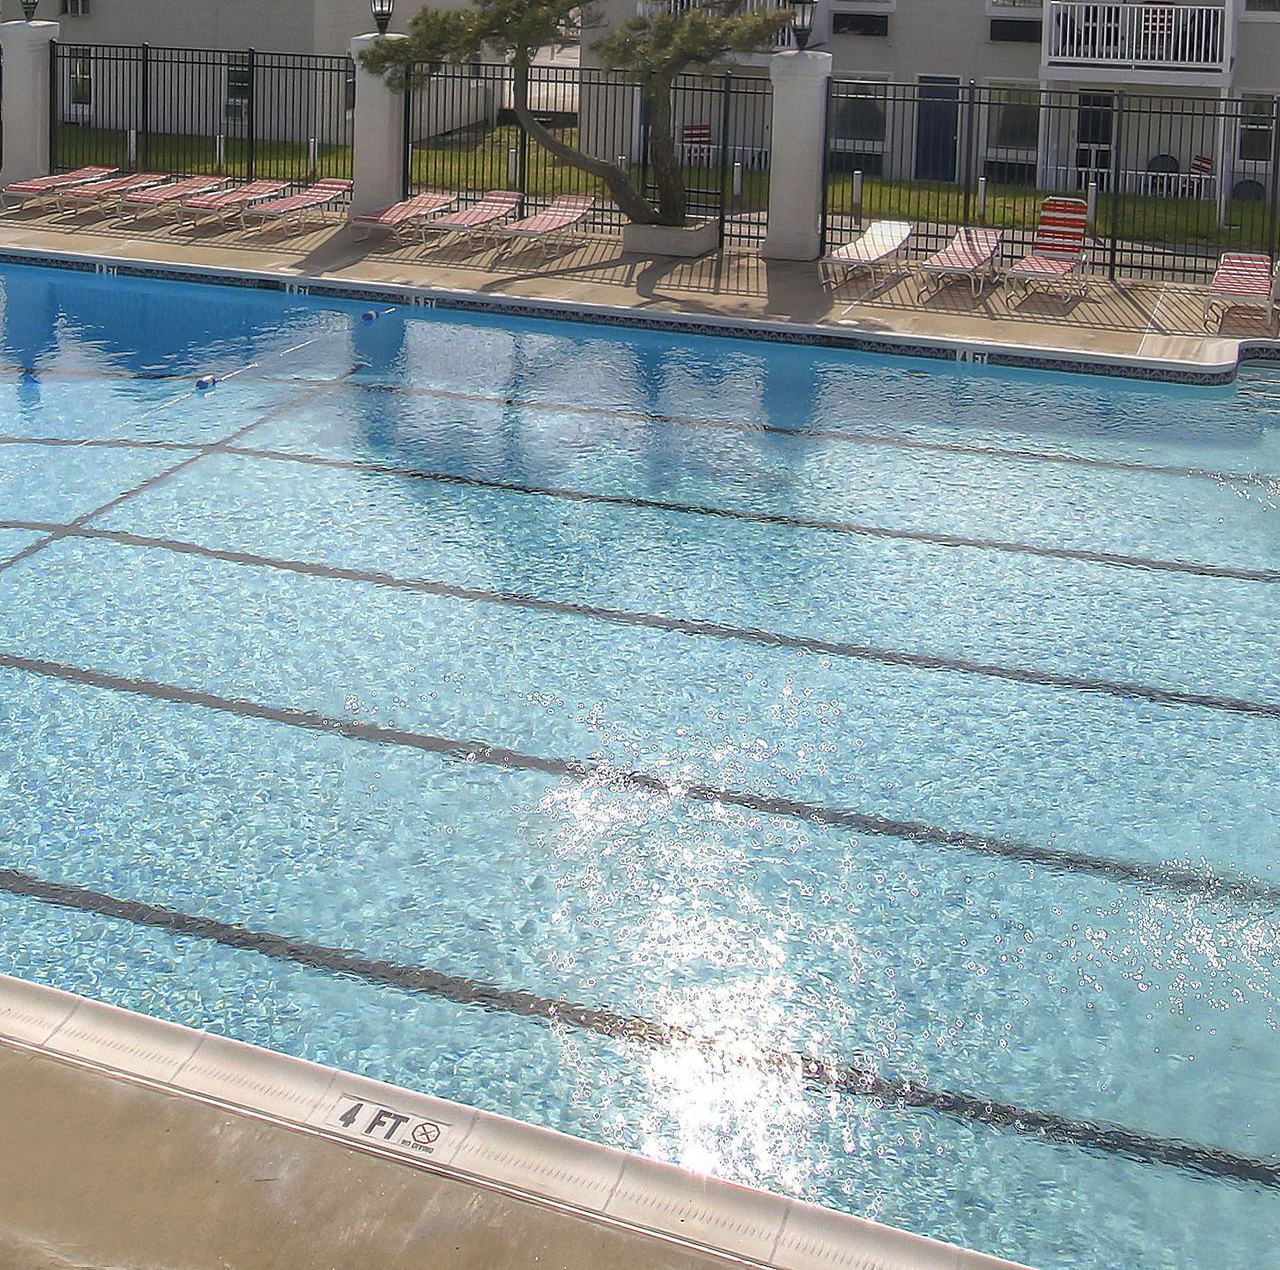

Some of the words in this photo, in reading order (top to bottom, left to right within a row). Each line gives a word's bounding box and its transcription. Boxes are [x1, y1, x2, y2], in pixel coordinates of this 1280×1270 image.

[423, 297, 434, 307] FT
[960, 351, 967, 362] 4
[972, 352, 986, 363] FT
[339, 1102, 364, 1128] 4
[364, 1109, 410, 1140] FT
